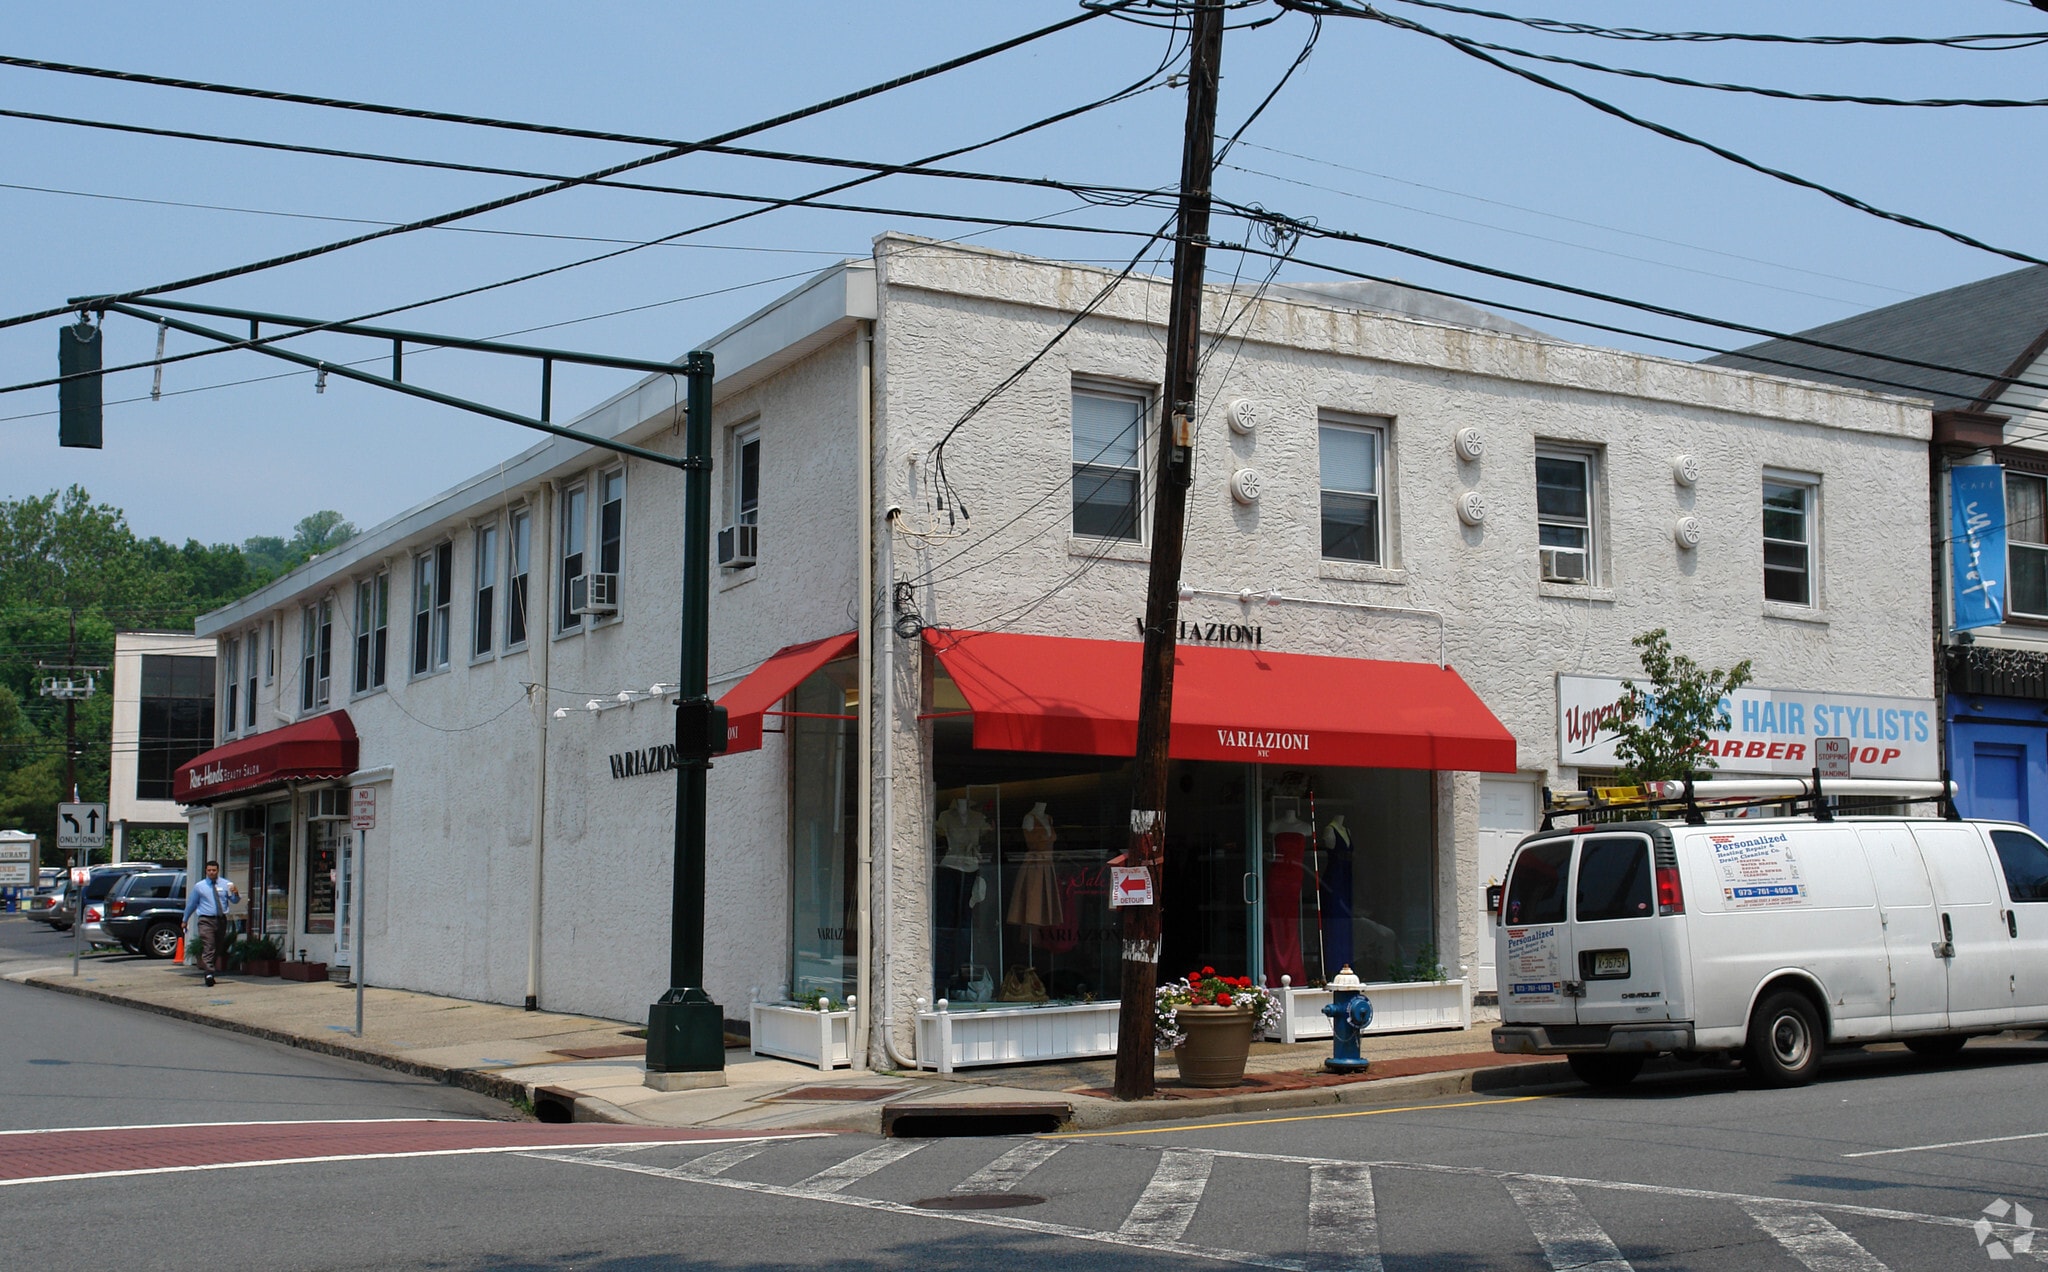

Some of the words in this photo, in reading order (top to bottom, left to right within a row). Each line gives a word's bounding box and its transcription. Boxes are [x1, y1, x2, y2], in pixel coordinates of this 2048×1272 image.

[1136, 617, 1263, 645] VIAZIONI
[1742, 699, 1806, 735] HAIR
[1813, 704, 1929, 743] STYLISTS
[1217, 729, 1310, 751] VARIAZIONI
[1825, 741, 1839, 752] NO
[1257, 749, 1270, 758] NYC
[1818, 753, 1848, 761] STOPPING
[609, 743, 679, 780] VARIAZION
[1828, 761, 1838, 769] OR
[1820, 770, 1848, 778] TANDING
[359, 790, 369, 799] NO
[60, 836, 79, 844] ONLY
[82, 836, 102, 844] ONLY
[1713, 833, 1788, 853] Personalized
[1717, 849, 1744, 858] Heating
[1745, 844, 1767, 853] Repair
[1719, 856, 1739, 864] Drain
[1740, 850, 1769, 860] Cleaning
[1508, 927, 1555, 948] Personalized
[1621, 991, 1661, 1000] CHEVROLET
